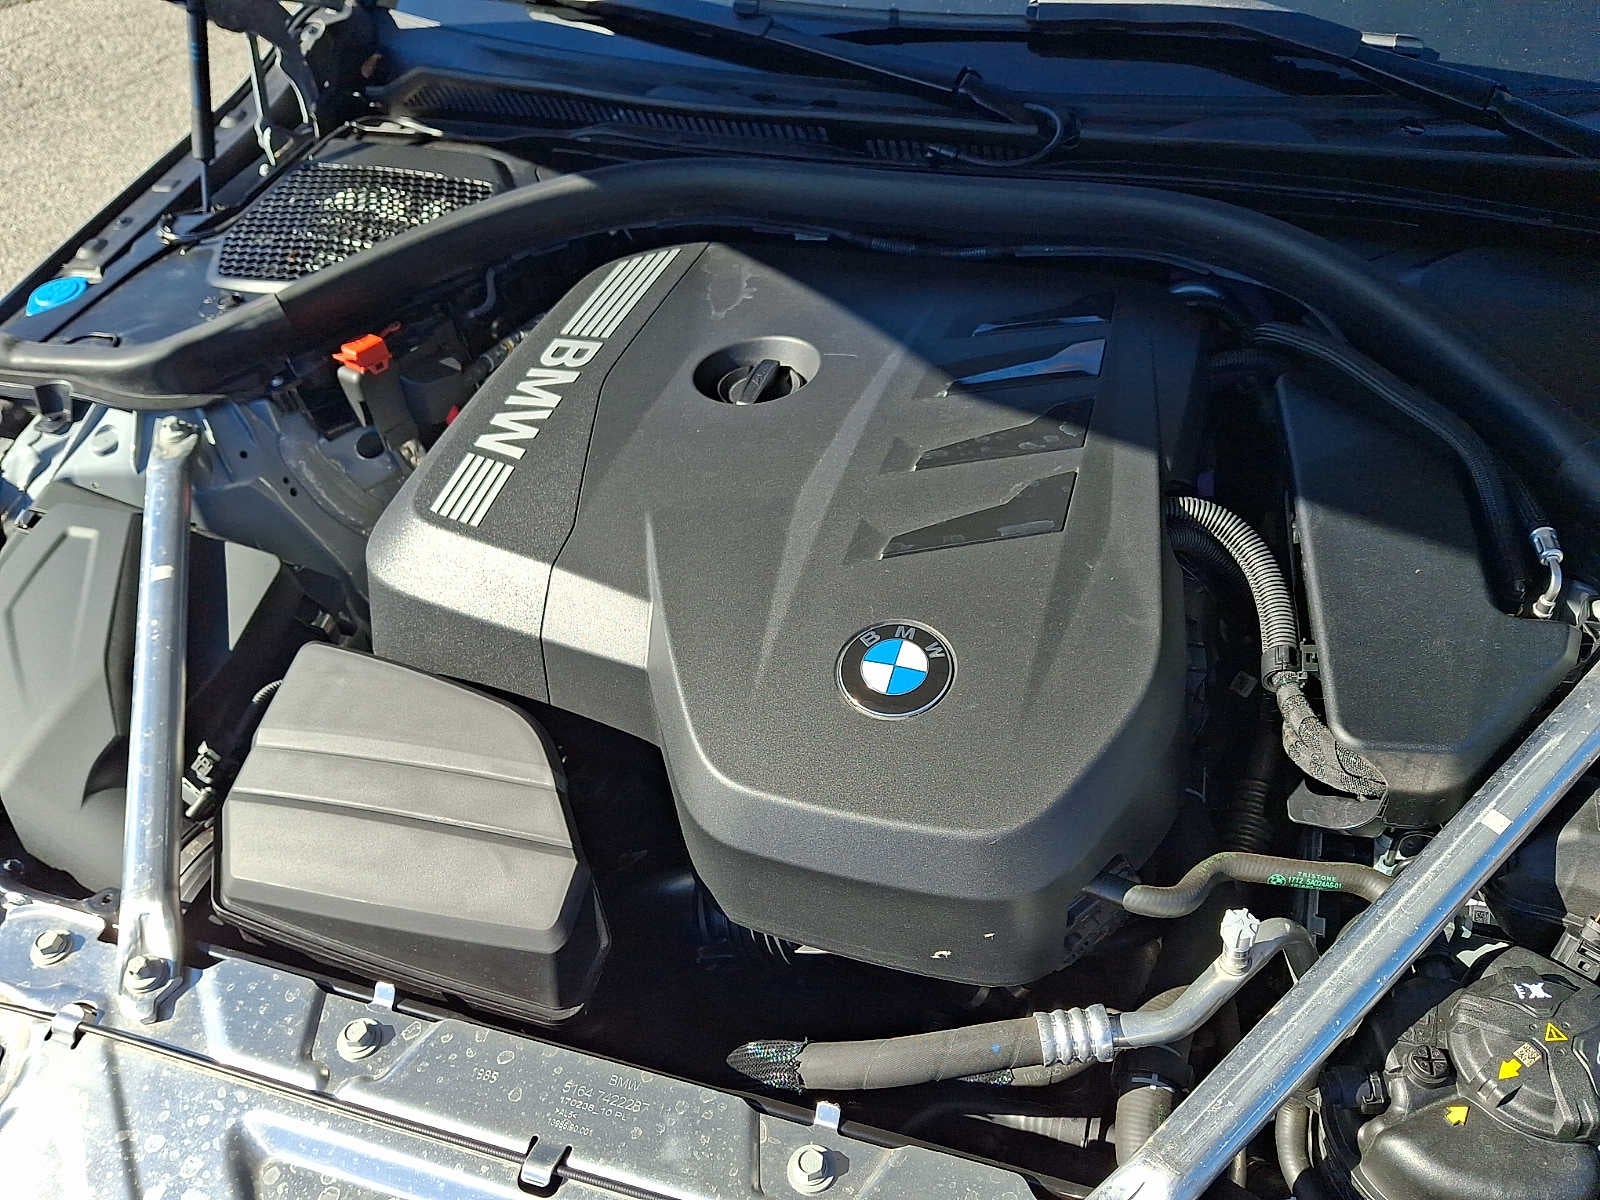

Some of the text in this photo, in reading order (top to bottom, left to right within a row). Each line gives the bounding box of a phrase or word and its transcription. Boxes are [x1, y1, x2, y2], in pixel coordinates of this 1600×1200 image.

[473, 338, 604, 460] BMW
[859, 625, 946, 659] BMW
[1297, 871, 1337, 882] TRISTONE
[562, 1080, 650, 1113] 5164 7422287
[608, 1074, 641, 1092] BMW
